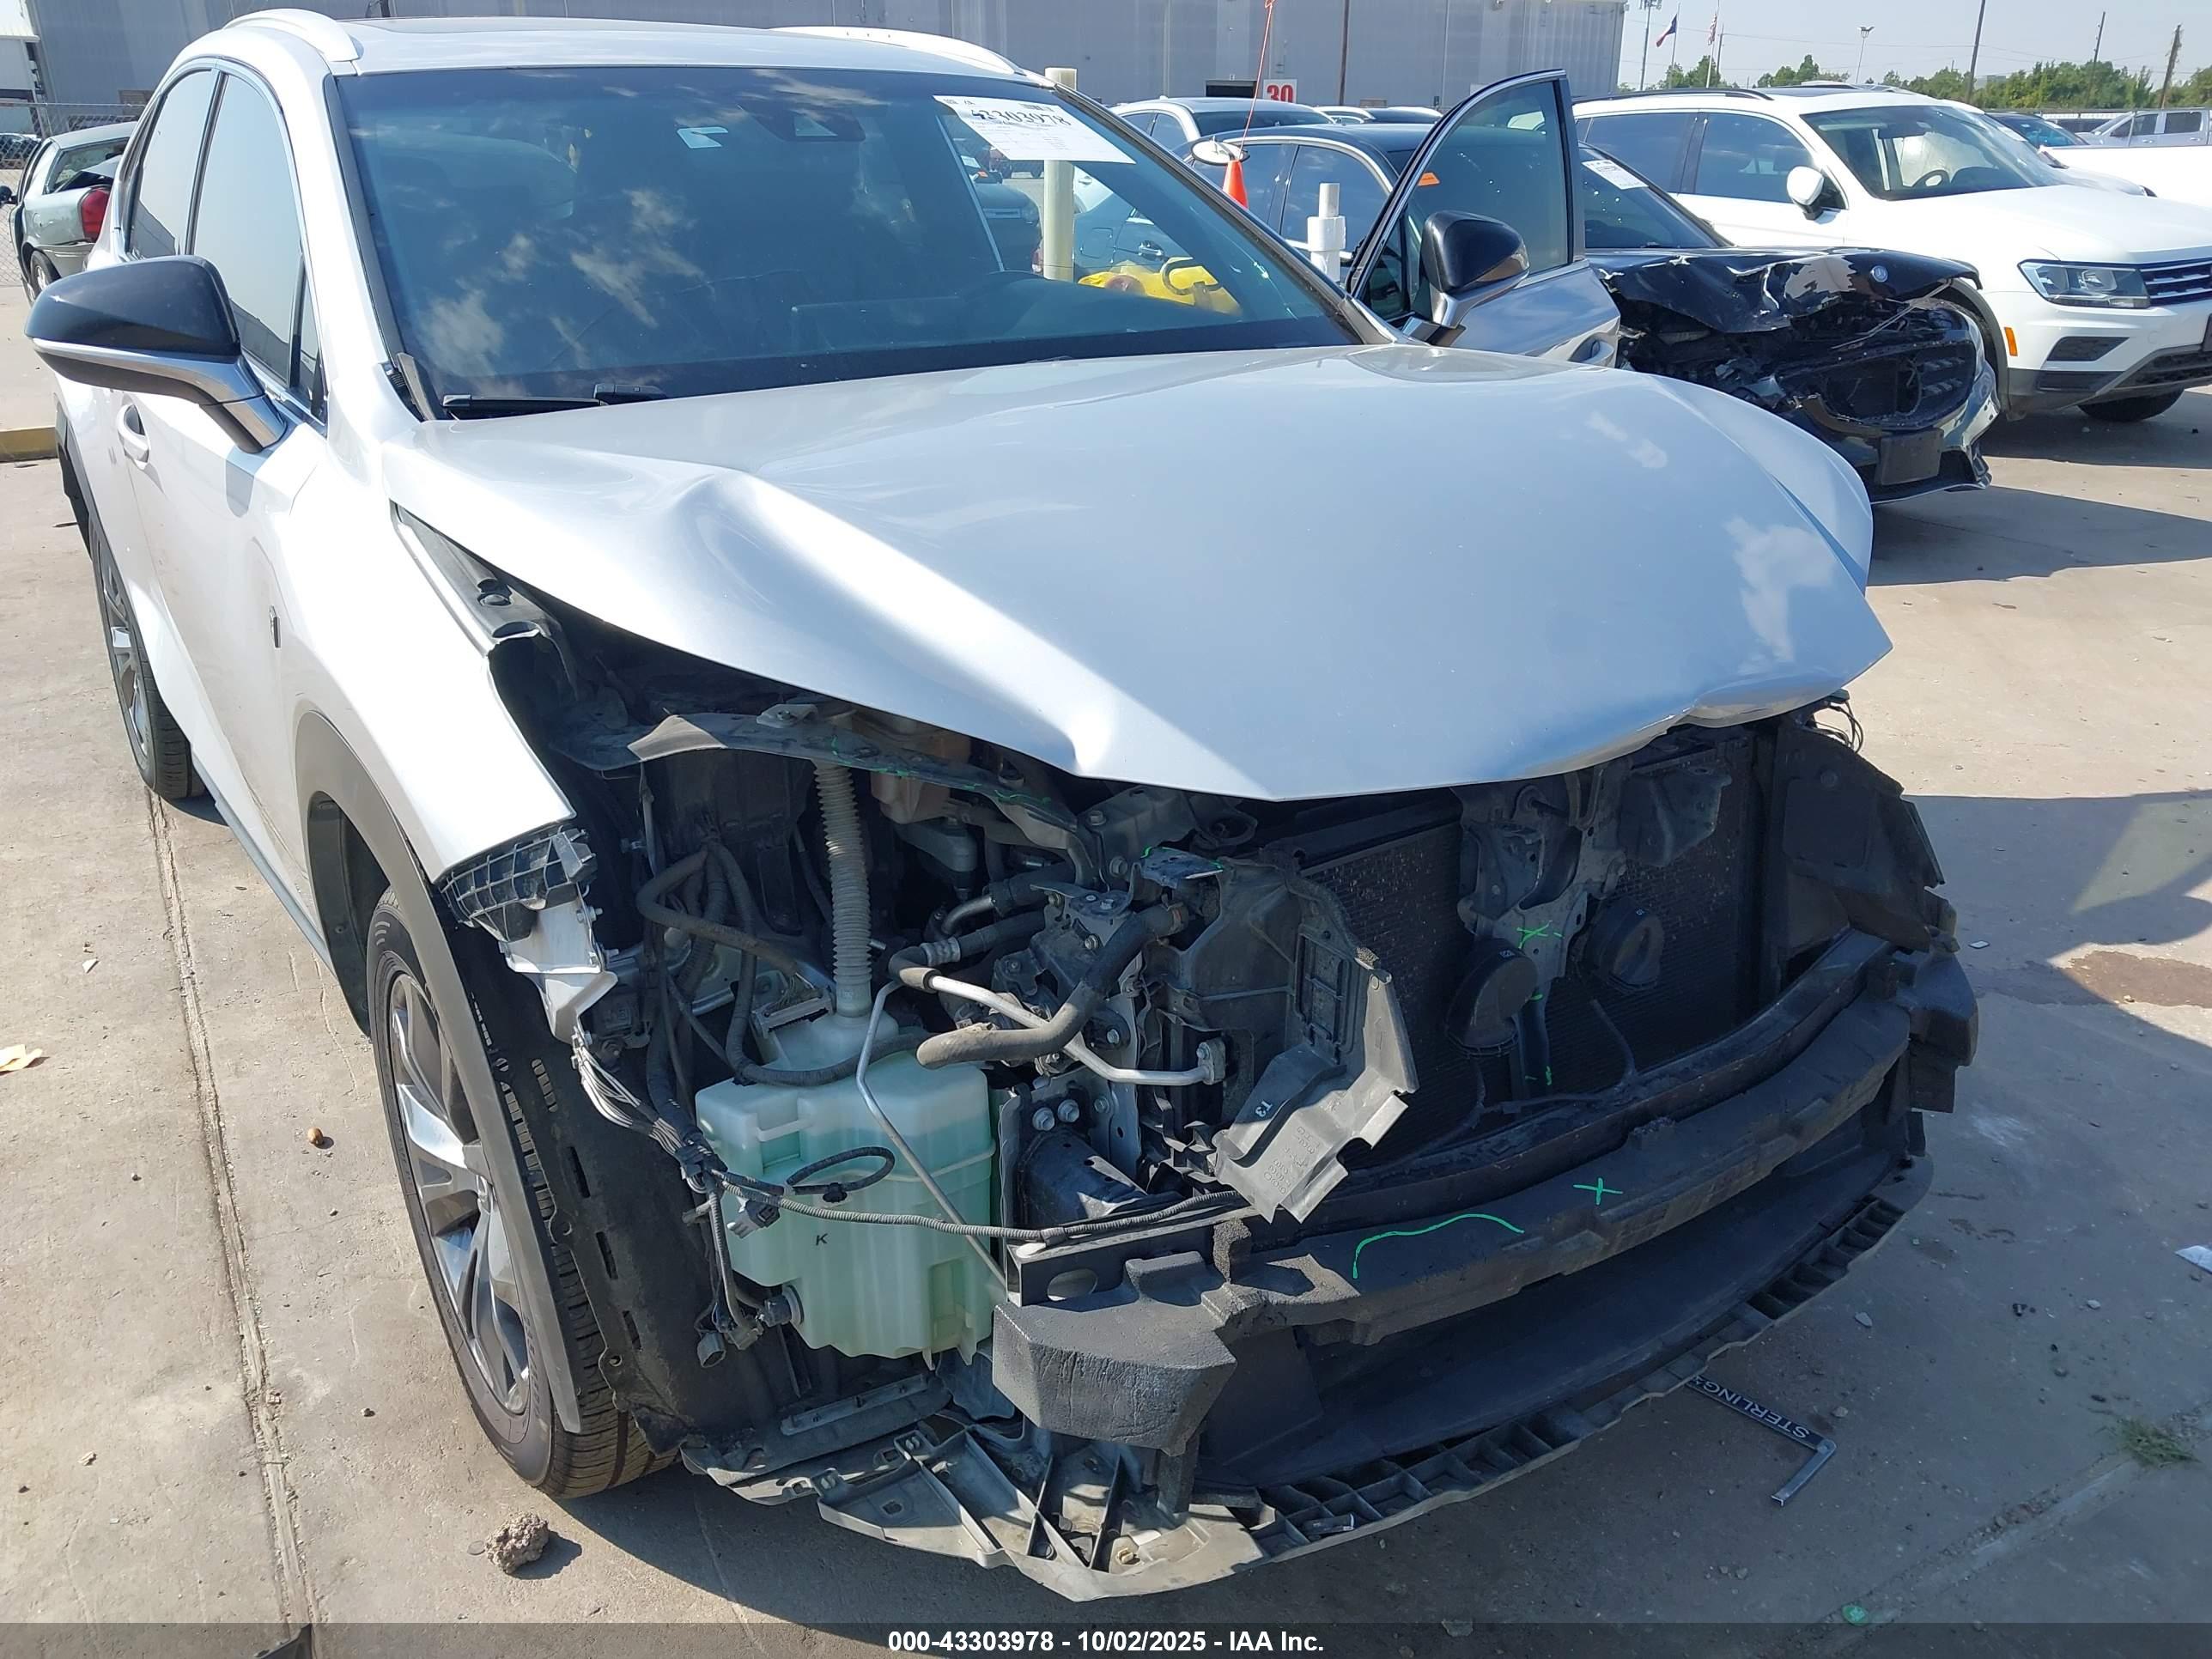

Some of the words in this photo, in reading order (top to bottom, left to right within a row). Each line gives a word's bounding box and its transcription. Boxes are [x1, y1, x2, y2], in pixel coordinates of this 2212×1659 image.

[1267, 84, 1294, 103] 30
[1255, 1100, 1273, 1118] T3
[816, 1233, 829, 1246] K
[1704, 1381, 1809, 1438] STERLING
